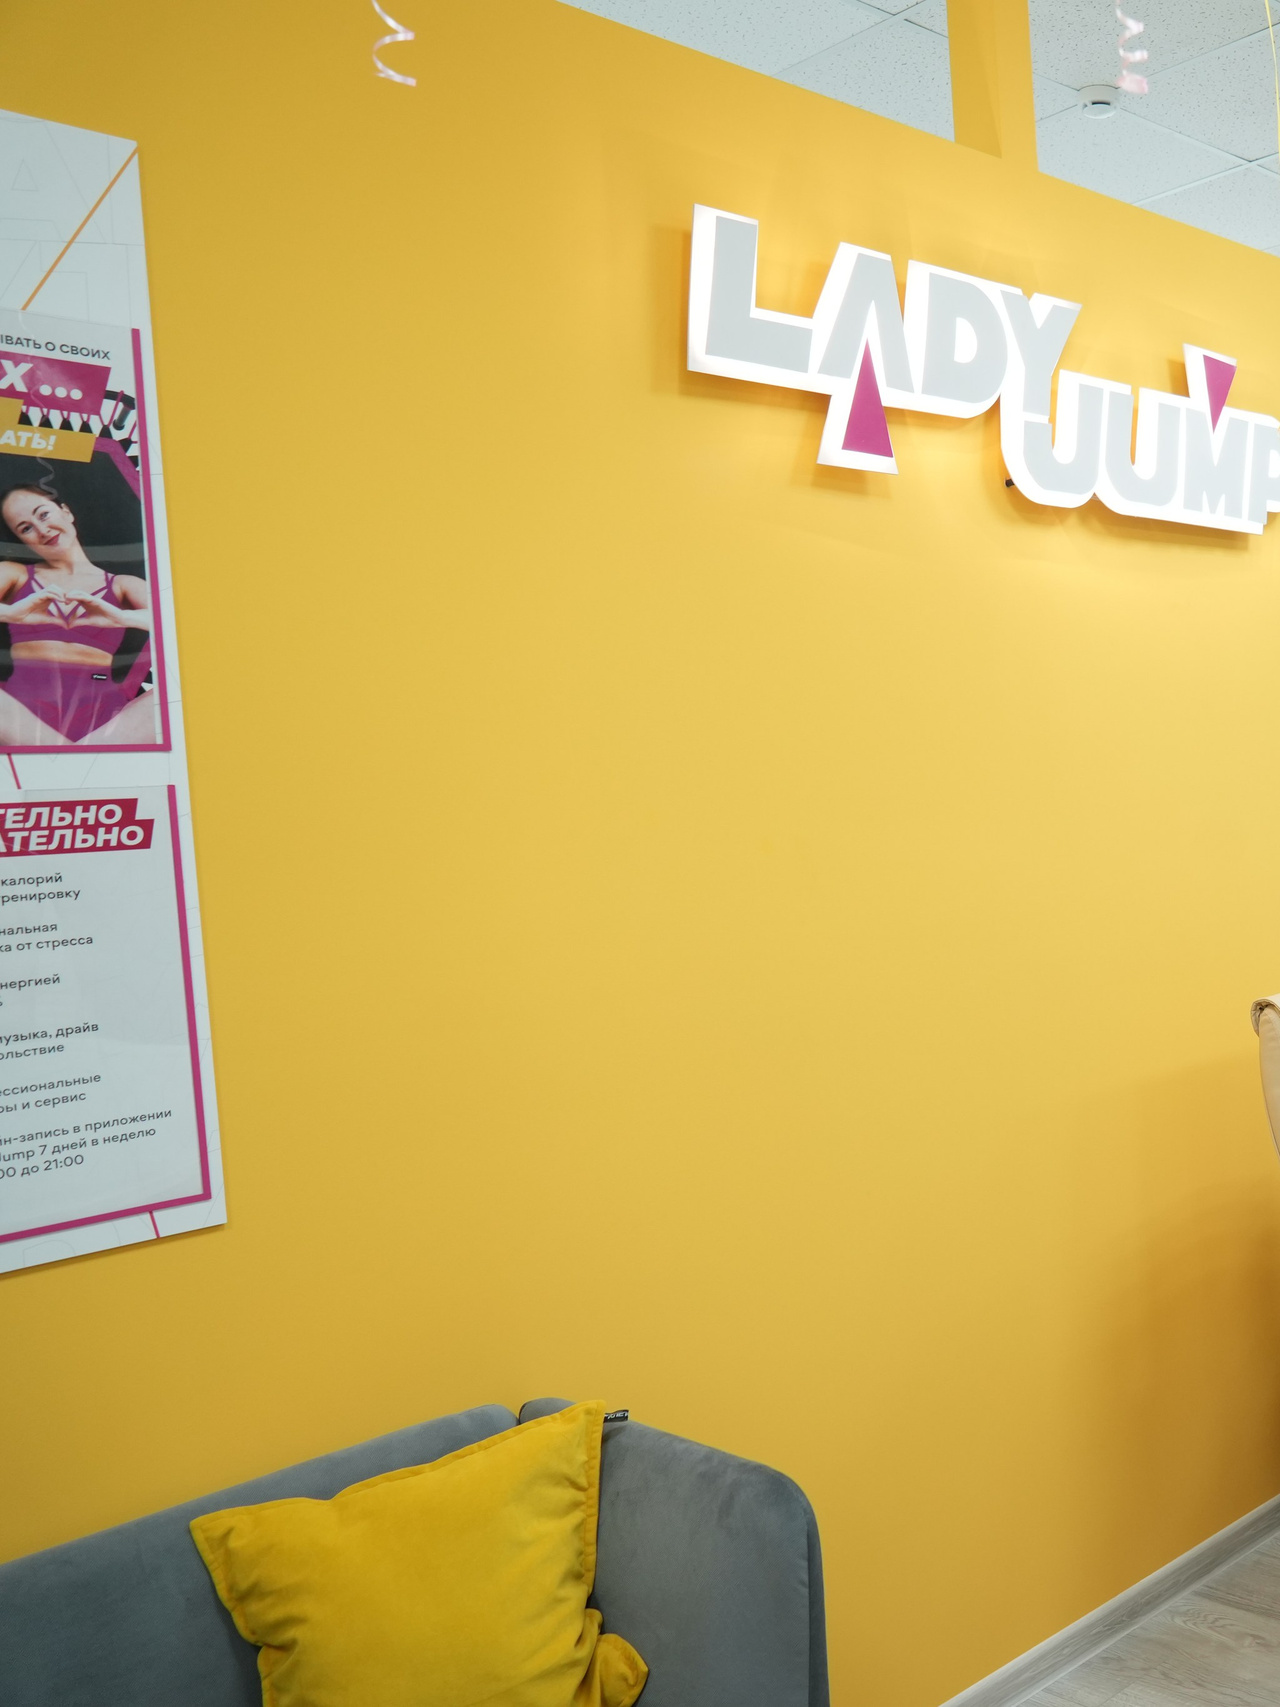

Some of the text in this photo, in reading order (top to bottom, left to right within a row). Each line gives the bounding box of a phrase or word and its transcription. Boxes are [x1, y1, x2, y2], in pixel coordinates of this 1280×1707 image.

[705, 215, 1082, 458] LADY
[45, 342, 56, 351] О
[60, 344, 111, 360] СВОИХ
[1, 872, 63, 887] калорий
[0, 889, 81, 905] ренировку
[16, 942, 33, 951] от
[36, 936, 94, 950] стресса
[0, 973, 61, 990] нергией
[55, 1022, 99, 1038] драйв
[22, 1102, 30, 1110] и
[35, 1092, 87, 1108] сервис
[73, 1125, 81, 1134] в
[85, 1109, 172, 1133] приложении
[38, 1144, 47, 1155] 7
[51, 1137, 87, 1155] дней
[91, 1137, 99, 1146] в
[103, 1127, 156, 1145] неделю
[20, 1164, 39, 1177] до
[43, 1154, 84, 1171] 21:00
